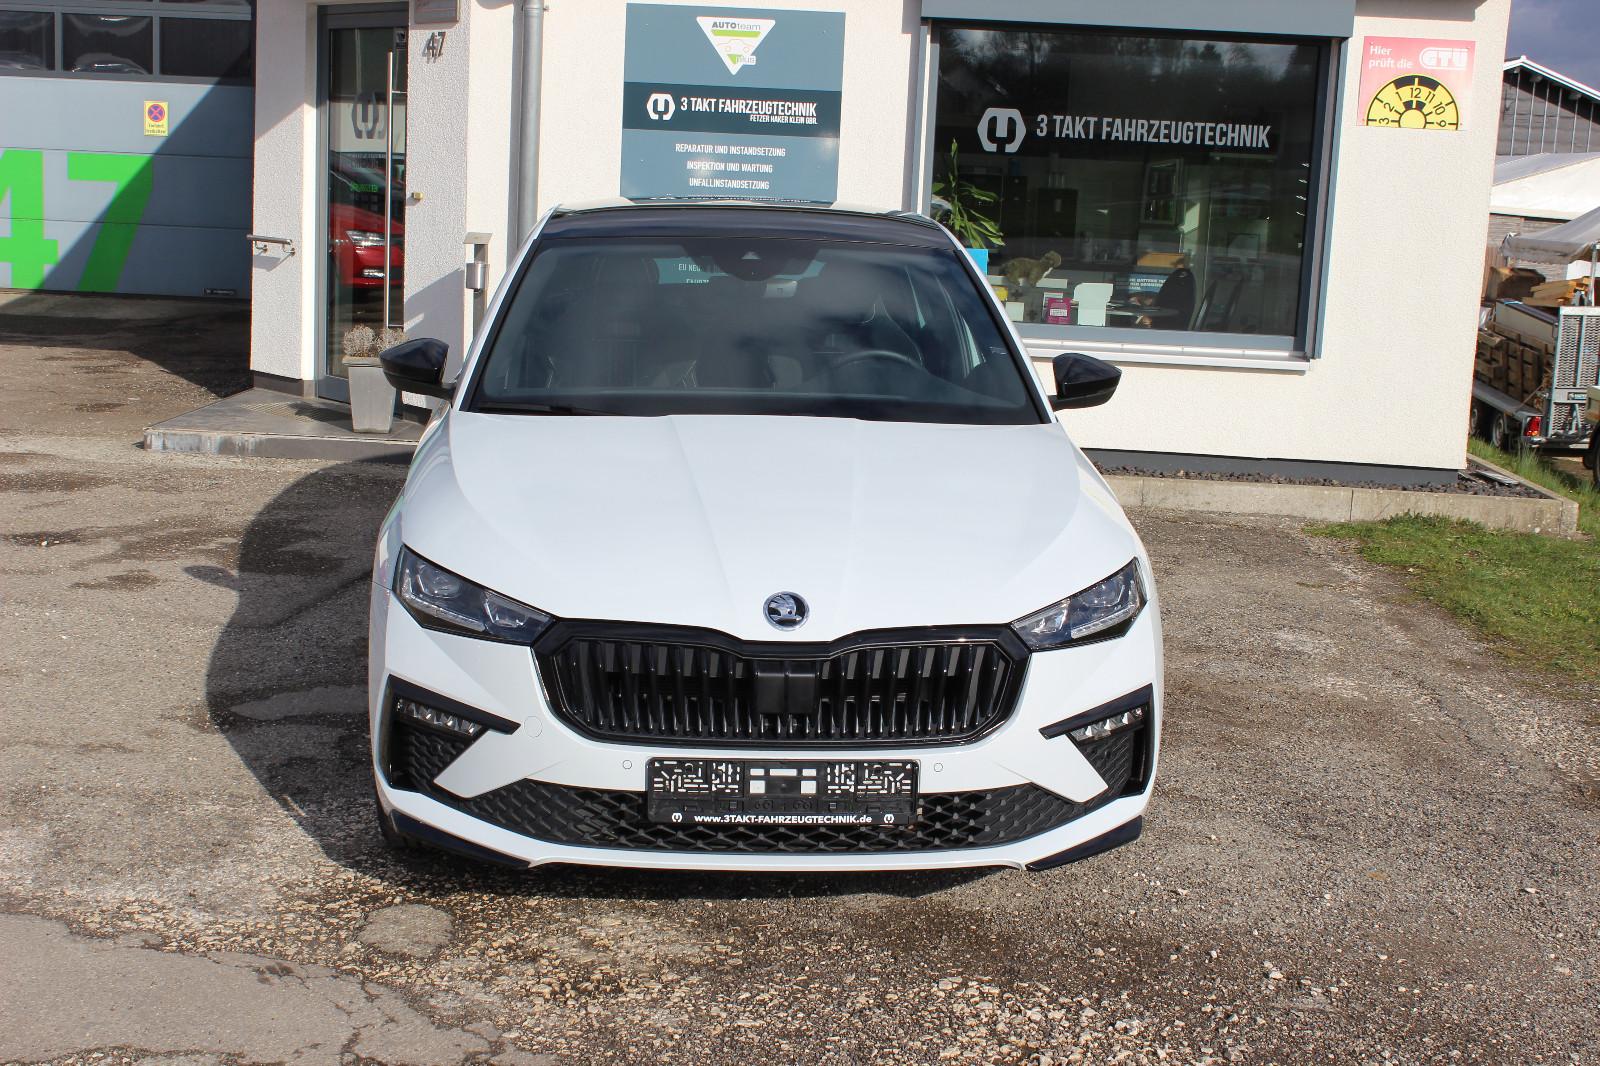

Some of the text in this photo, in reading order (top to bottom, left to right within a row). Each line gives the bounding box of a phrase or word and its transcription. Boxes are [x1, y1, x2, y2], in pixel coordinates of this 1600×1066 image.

[427, 31, 447, 58] 47
[1370, 45, 1393, 55] Hier
[1368, 57, 1413, 69] prüft die
[1409, 87, 1422, 99] 12
[1424, 91, 1436, 104] 11
[680, 97, 817, 117] 3 TAKT FAHRZEUGTECHNIK
[1383, 101, 1395, 112] 2
[1433, 101, 1446, 115] 10
[750, 114, 770, 123] FETZER
[789, 116, 805, 125] KLEIN
[1378, 117, 1390, 125] 3
[1036, 114, 1272, 148] 3 TAKT FAHRZEUGTECHNIK
[675, 143, 786, 157] REPARATUR UND INSTANDSETZUNG
[686, 160, 773, 174] INSPEKTION UND WARTUNG
[689, 178, 770, 190] UNFALLINSTANDSETZUNG
[0, 148, 153, 292] 47
[694, 813, 873, 824] www.3TAKT-FAHRZEUGTECHNIK.de
